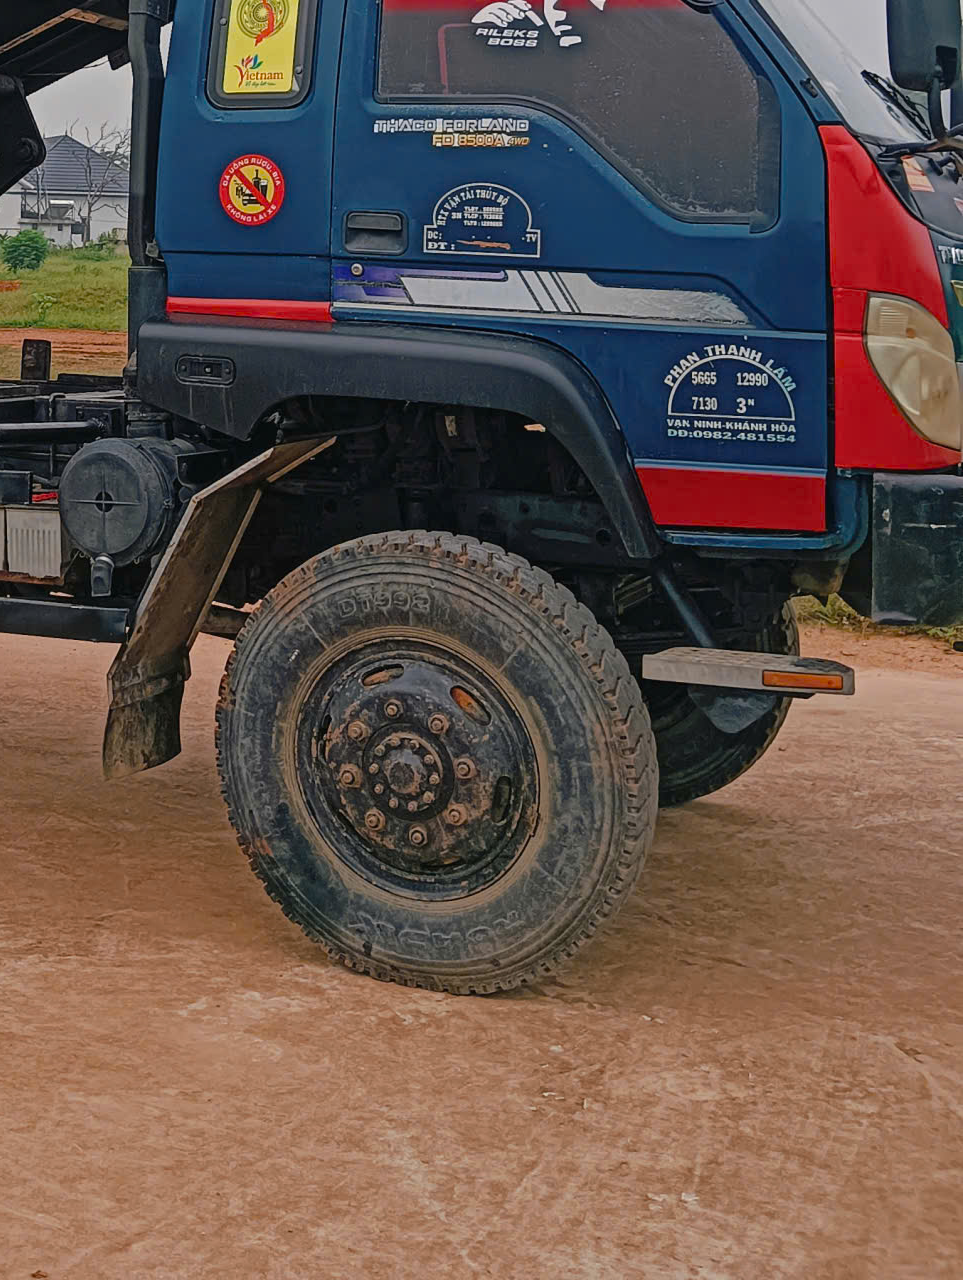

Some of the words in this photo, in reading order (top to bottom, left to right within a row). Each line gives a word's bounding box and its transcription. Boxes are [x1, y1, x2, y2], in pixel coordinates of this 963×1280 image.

[476, 28, 539, 38] RILEKS
[487, 38, 538, 48] BOSS
[233, 65, 284, 88] Vietnam
[374, 119, 436, 133] THACO
[443, 118, 529, 132] FORLAND
[432, 134, 454, 146] FD
[458, 134, 505, 147] 8500A
[508, 137, 530, 146] 4WD
[664, 352, 700, 387] PHAN
[704, 344, 763, 363] THANH
[691, 371, 717, 385] 5665
[736, 372, 769, 386] 12990
[691, 397, 718, 411] 7130
[771, 422, 797, 433] HÒA
